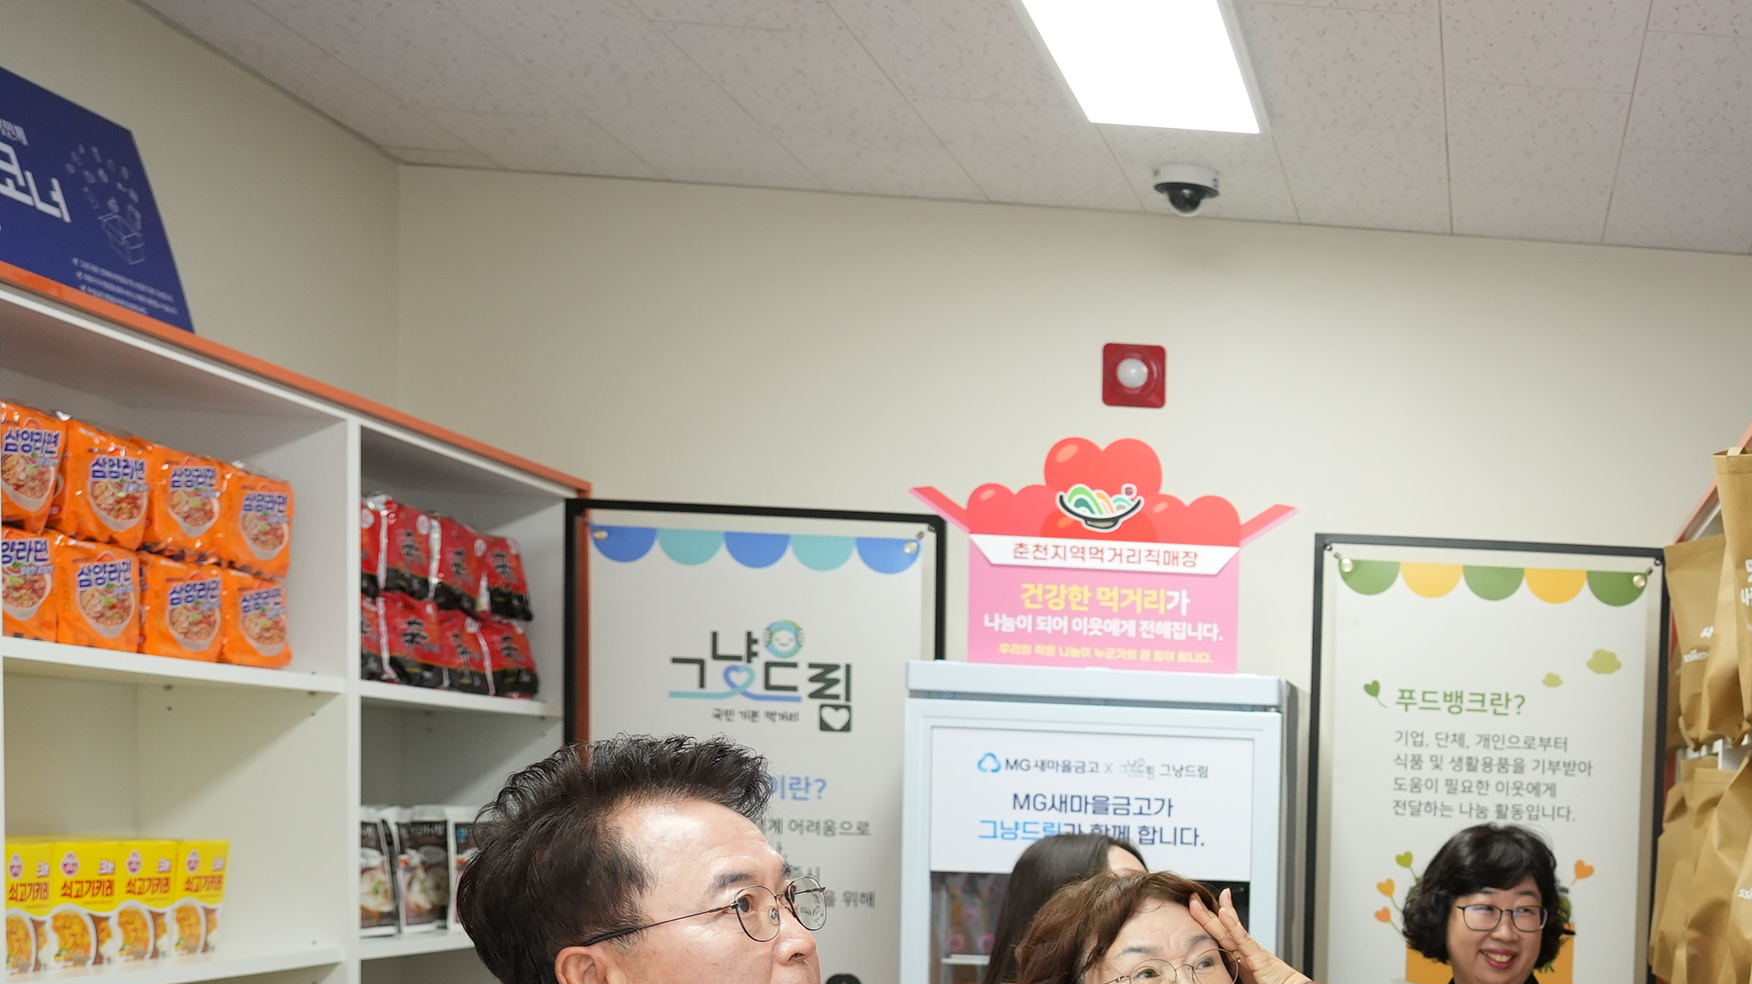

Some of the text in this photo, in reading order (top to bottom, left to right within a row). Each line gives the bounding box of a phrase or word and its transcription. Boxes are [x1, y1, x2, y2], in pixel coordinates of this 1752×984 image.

[4, 427, 62, 456] 삼양라면
[1012, 541, 1200, 568] 춘천지역먹거리직매장
[78, 558, 133, 589] 삼양라면
[1020, 582, 1191, 617] 건강한 먹거리가
[982, 612, 1225, 642] 나눔이 되어 이웃에게 전해집니다.
[998, 642, 1033, 656] 우리의
[1059, 645, 1093, 659] 나눔이
[1094, 647, 1138, 661] 누군가의
[1395, 688, 1527, 716] 푸드뱅크란?
[740, 709, 761, 723] 기본
[1394, 730, 1569, 753] 기업, 단체, 개인으로부터
[1005, 758, 1032, 772] MG
[1033, 759, 1100, 774] 새마을금고
[1159, 763, 1209, 779] 그냥드림
[1393, 753, 1594, 777] 식품 및 생활용품을 기부받아
[1393, 776, 1558, 799] 도움이 필요한 이웃에게
[1011, 793, 1175, 818] MG새마을금고가
[1392, 799, 1577, 823] 전달하는 나눔 활동입니다.
[787, 818, 871, 838] 어려움으로
[1137, 825, 1206, 847] 합니다.
[842, 891, 876, 909] 위해
